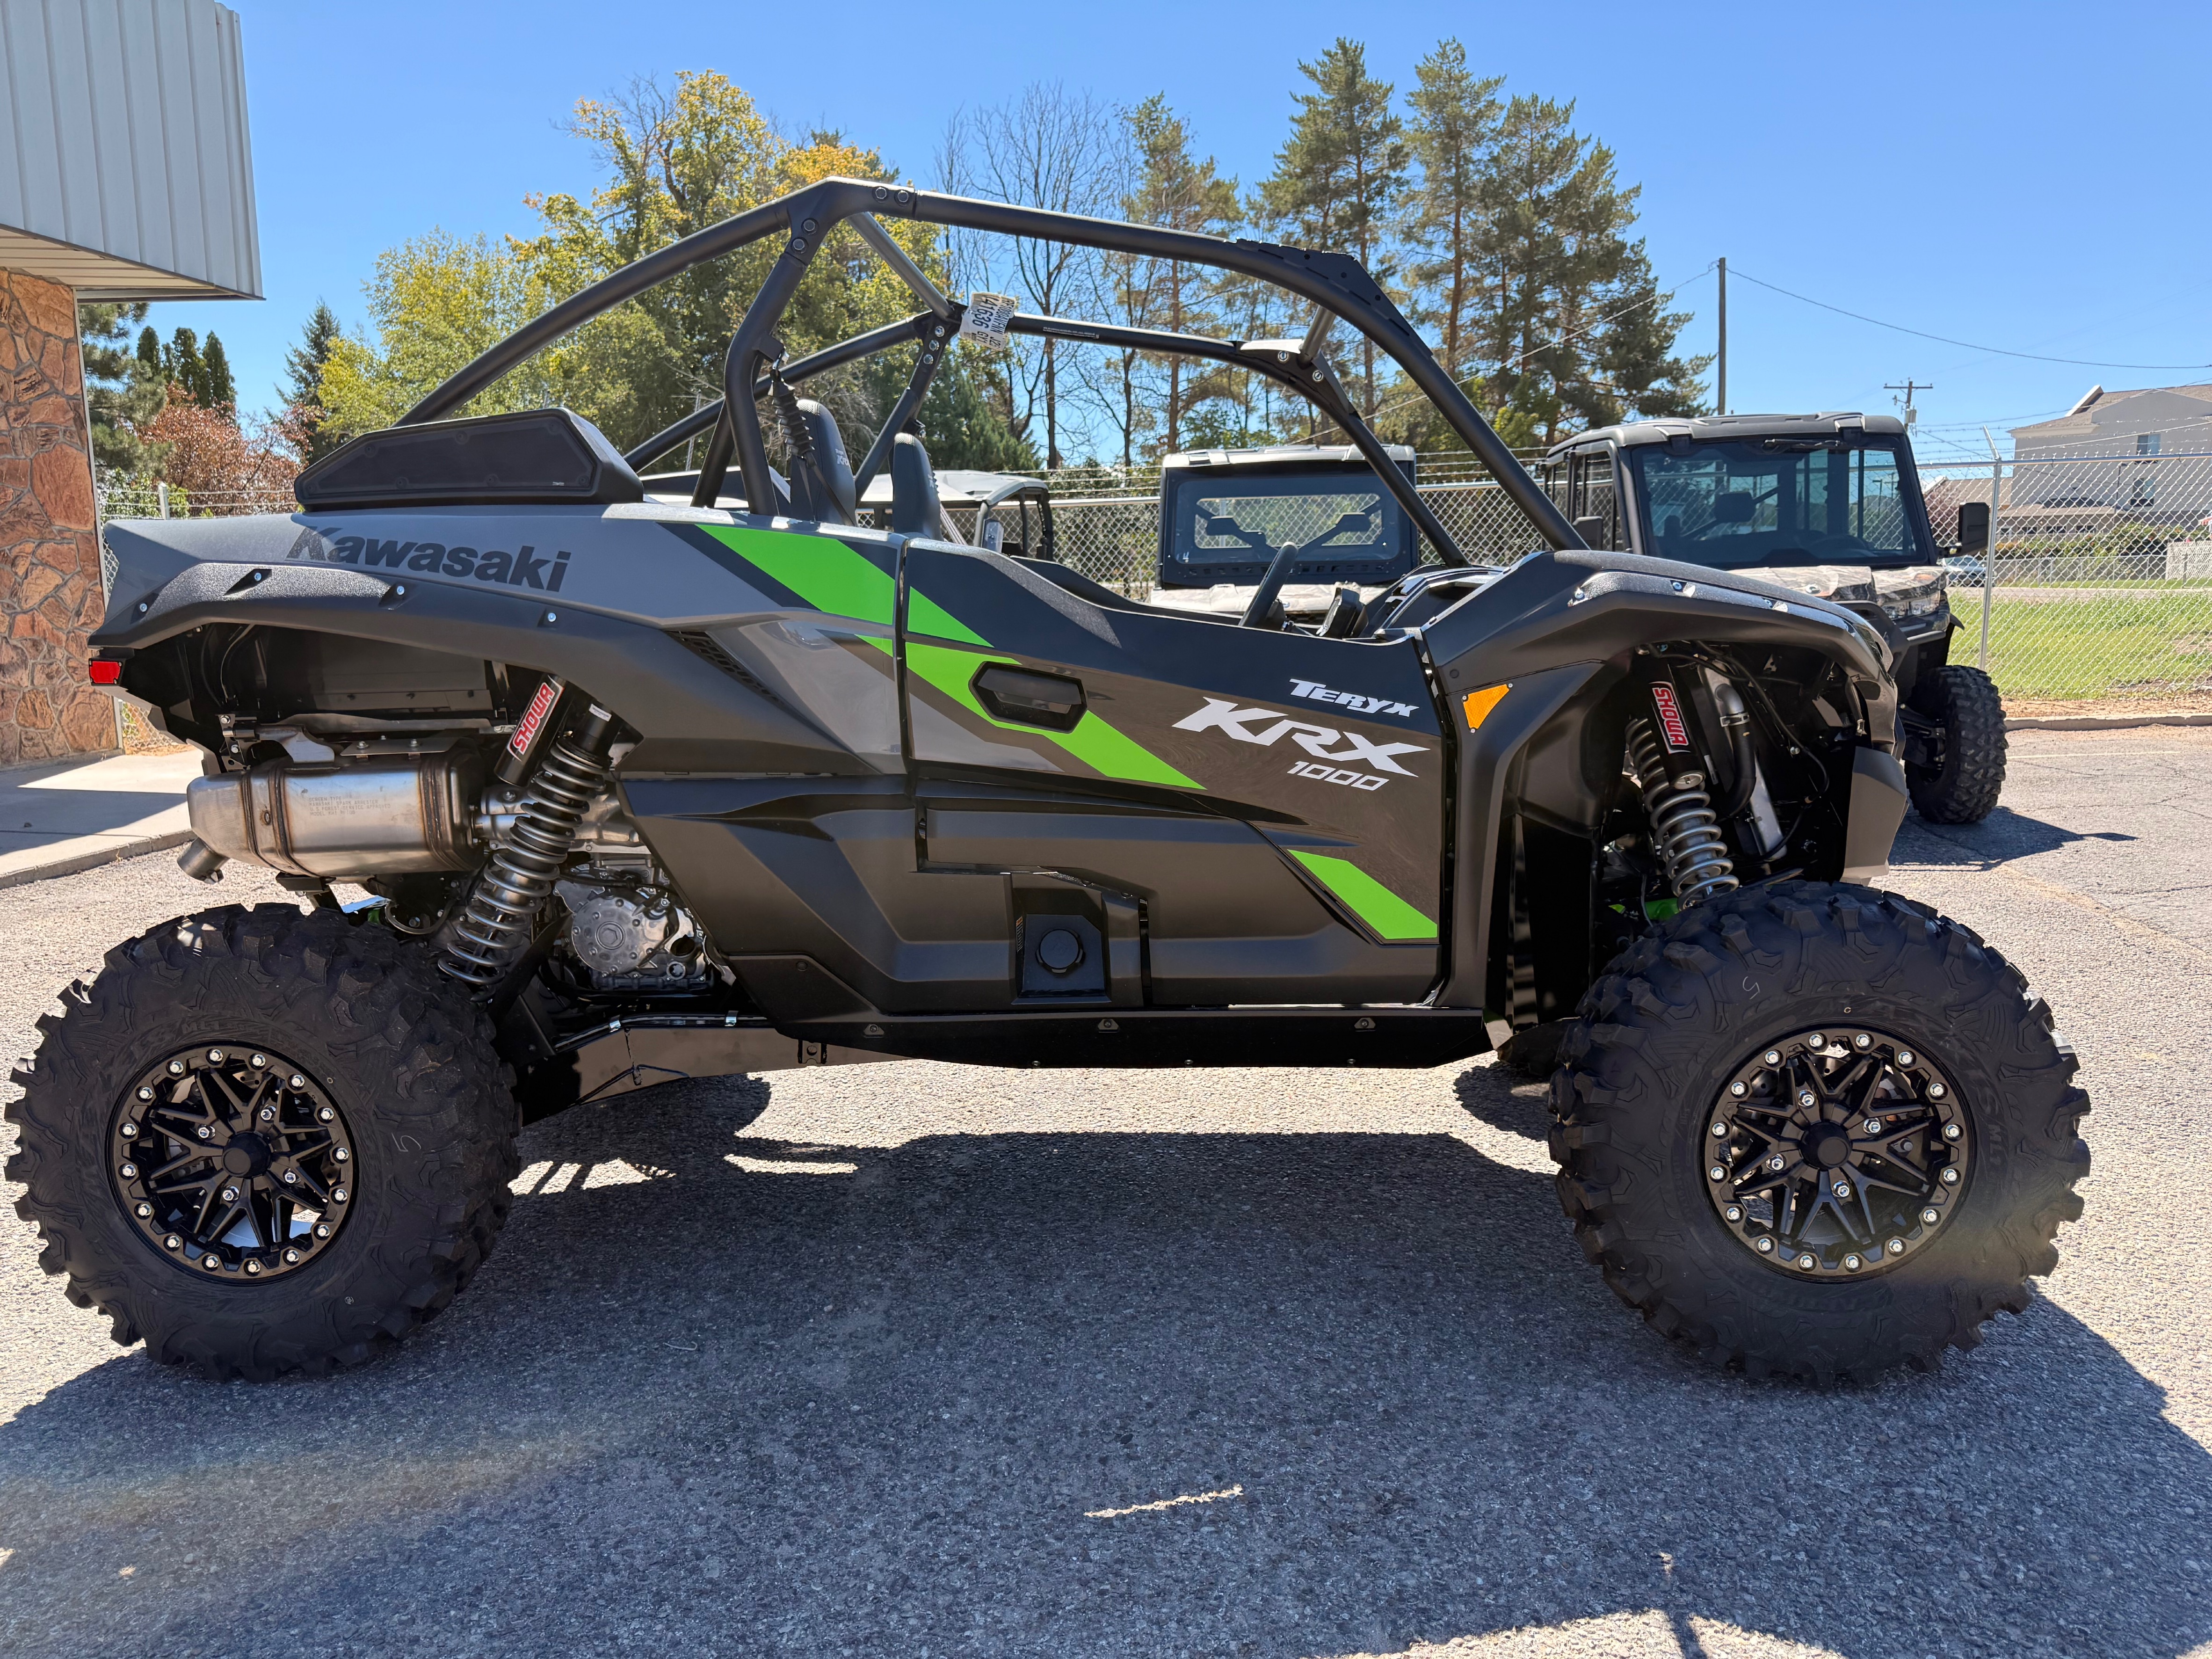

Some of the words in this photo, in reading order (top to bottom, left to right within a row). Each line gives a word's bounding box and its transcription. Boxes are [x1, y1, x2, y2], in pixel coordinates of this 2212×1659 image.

[284, 526, 572, 592] Kawasaki
[513, 682, 556, 755] SHOWA
[1171, 697, 1431, 778] KRX
[1652, 687, 1689, 746] SHOWA
[1287, 761, 1390, 791] 1000
